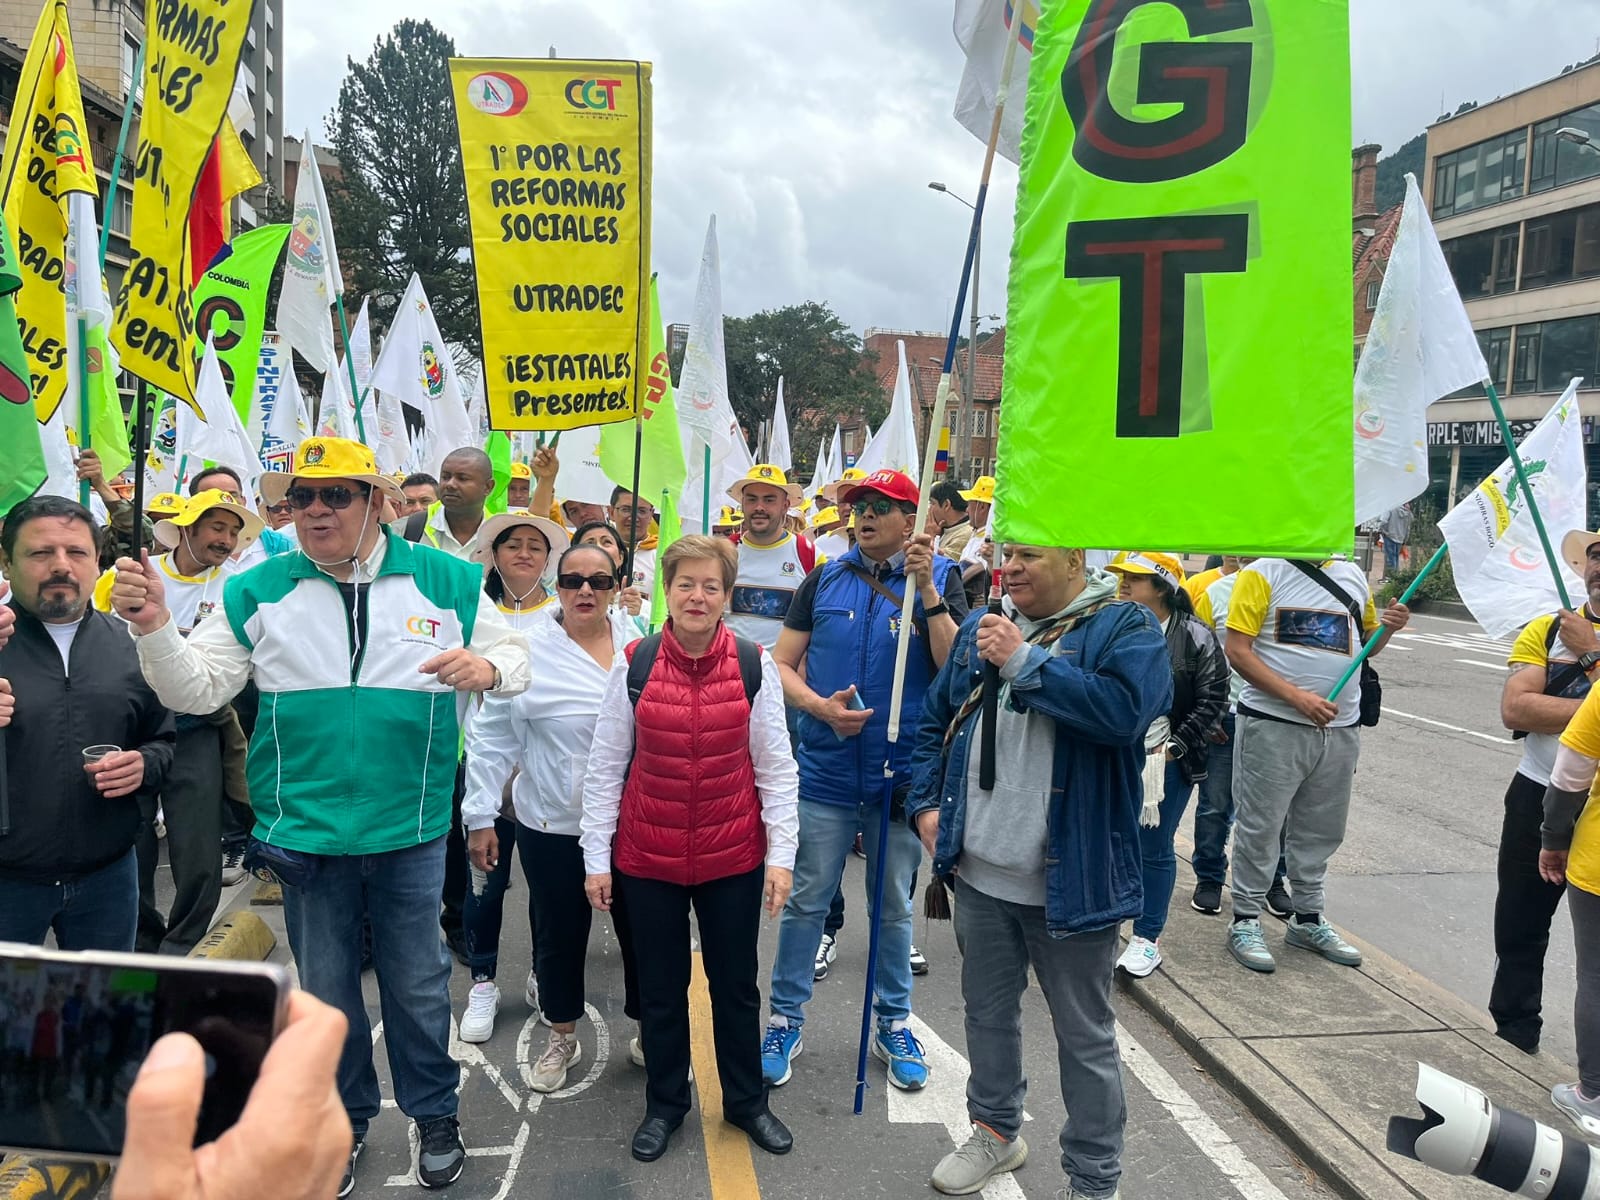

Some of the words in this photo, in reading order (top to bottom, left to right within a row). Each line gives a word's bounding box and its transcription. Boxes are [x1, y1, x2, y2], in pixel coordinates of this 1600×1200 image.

[565, 79, 622, 110] CGT
[516, 143, 571, 171] POR
[577, 145, 621, 175] LAS
[491, 178, 626, 211] REFORMAS
[501, 213, 618, 244] SOCIALES
[208, 271, 249, 290] COLOMBIA
[514, 284, 624, 313] UTRADEC
[1155, 564, 1169, 576] CGT
[406, 616, 441, 638] CGT
